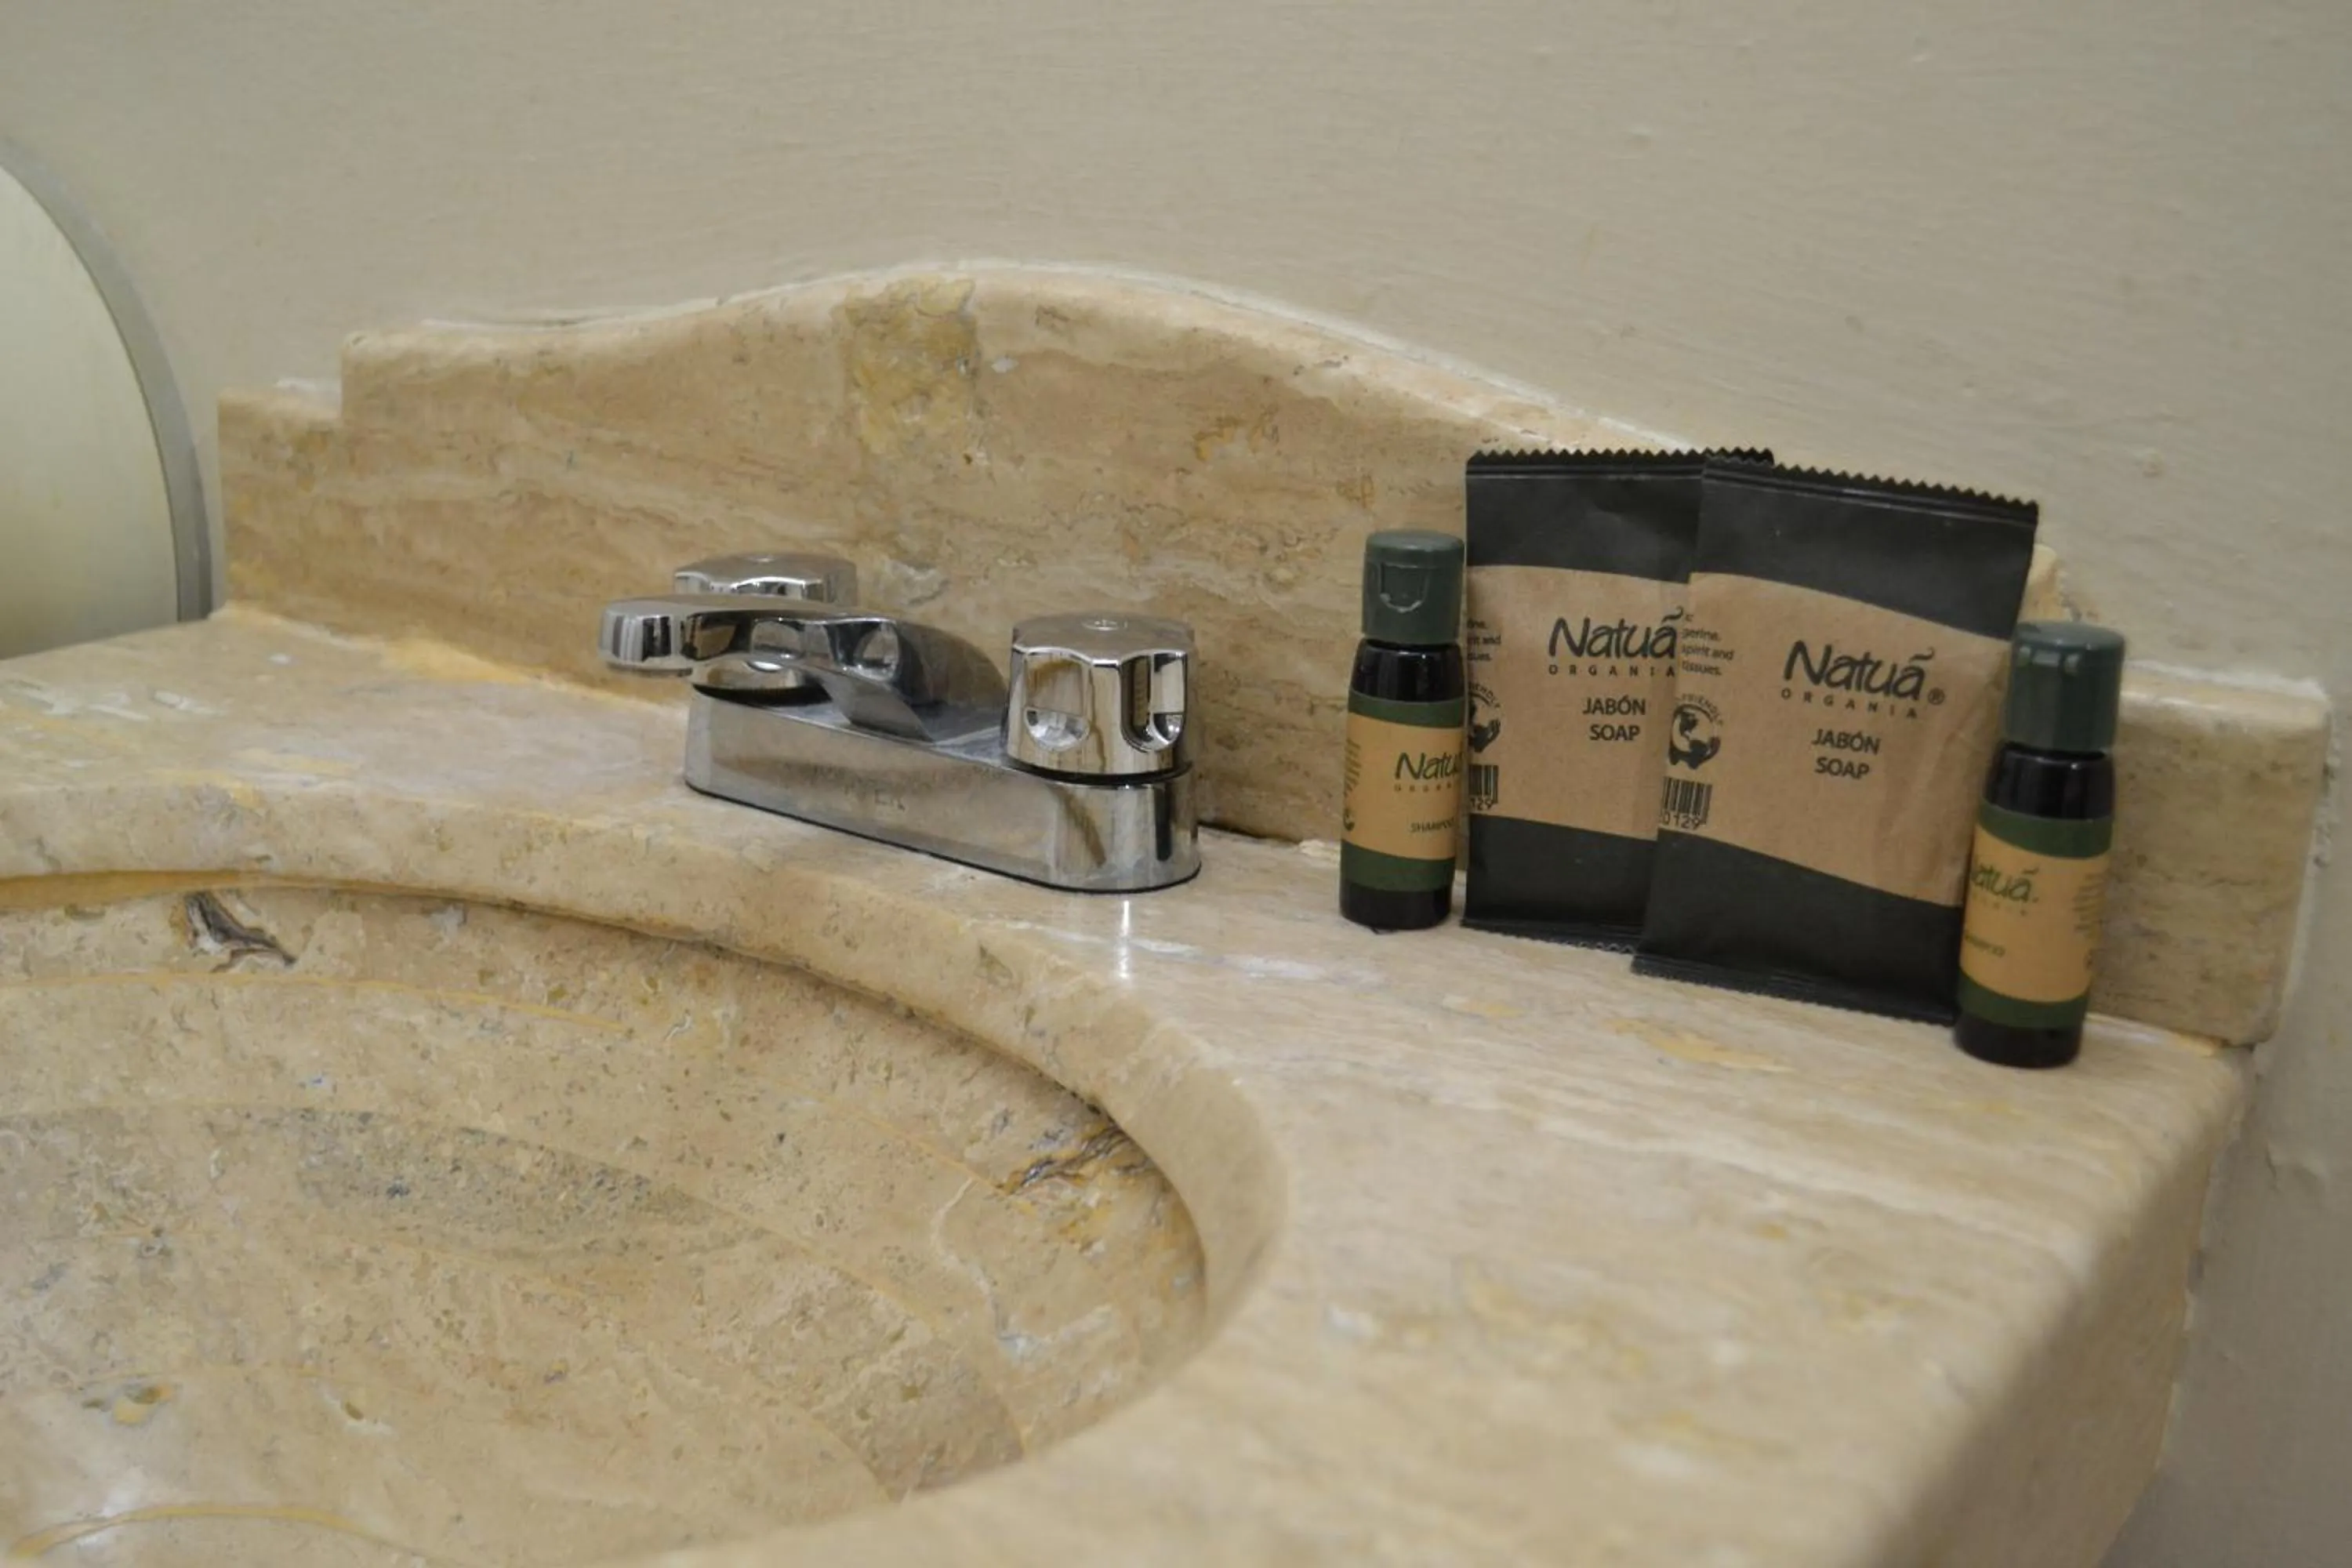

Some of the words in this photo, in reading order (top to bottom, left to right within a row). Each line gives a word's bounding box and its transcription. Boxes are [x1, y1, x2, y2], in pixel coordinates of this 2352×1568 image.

[1711, 648, 1735, 662] and
[1548, 664, 1675, 677] ORGANIA
[1784, 640, 1936, 701] Natuã
[1582, 695, 1646, 715] JABÓN
[1780, 688, 1918, 720] ORGANIA
[1589, 724, 1641, 742] SOAP
[1812, 728, 1881, 756] JABÓN
[1815, 757, 1870, 780] SOAP
[1970, 862, 2039, 904] atuã
